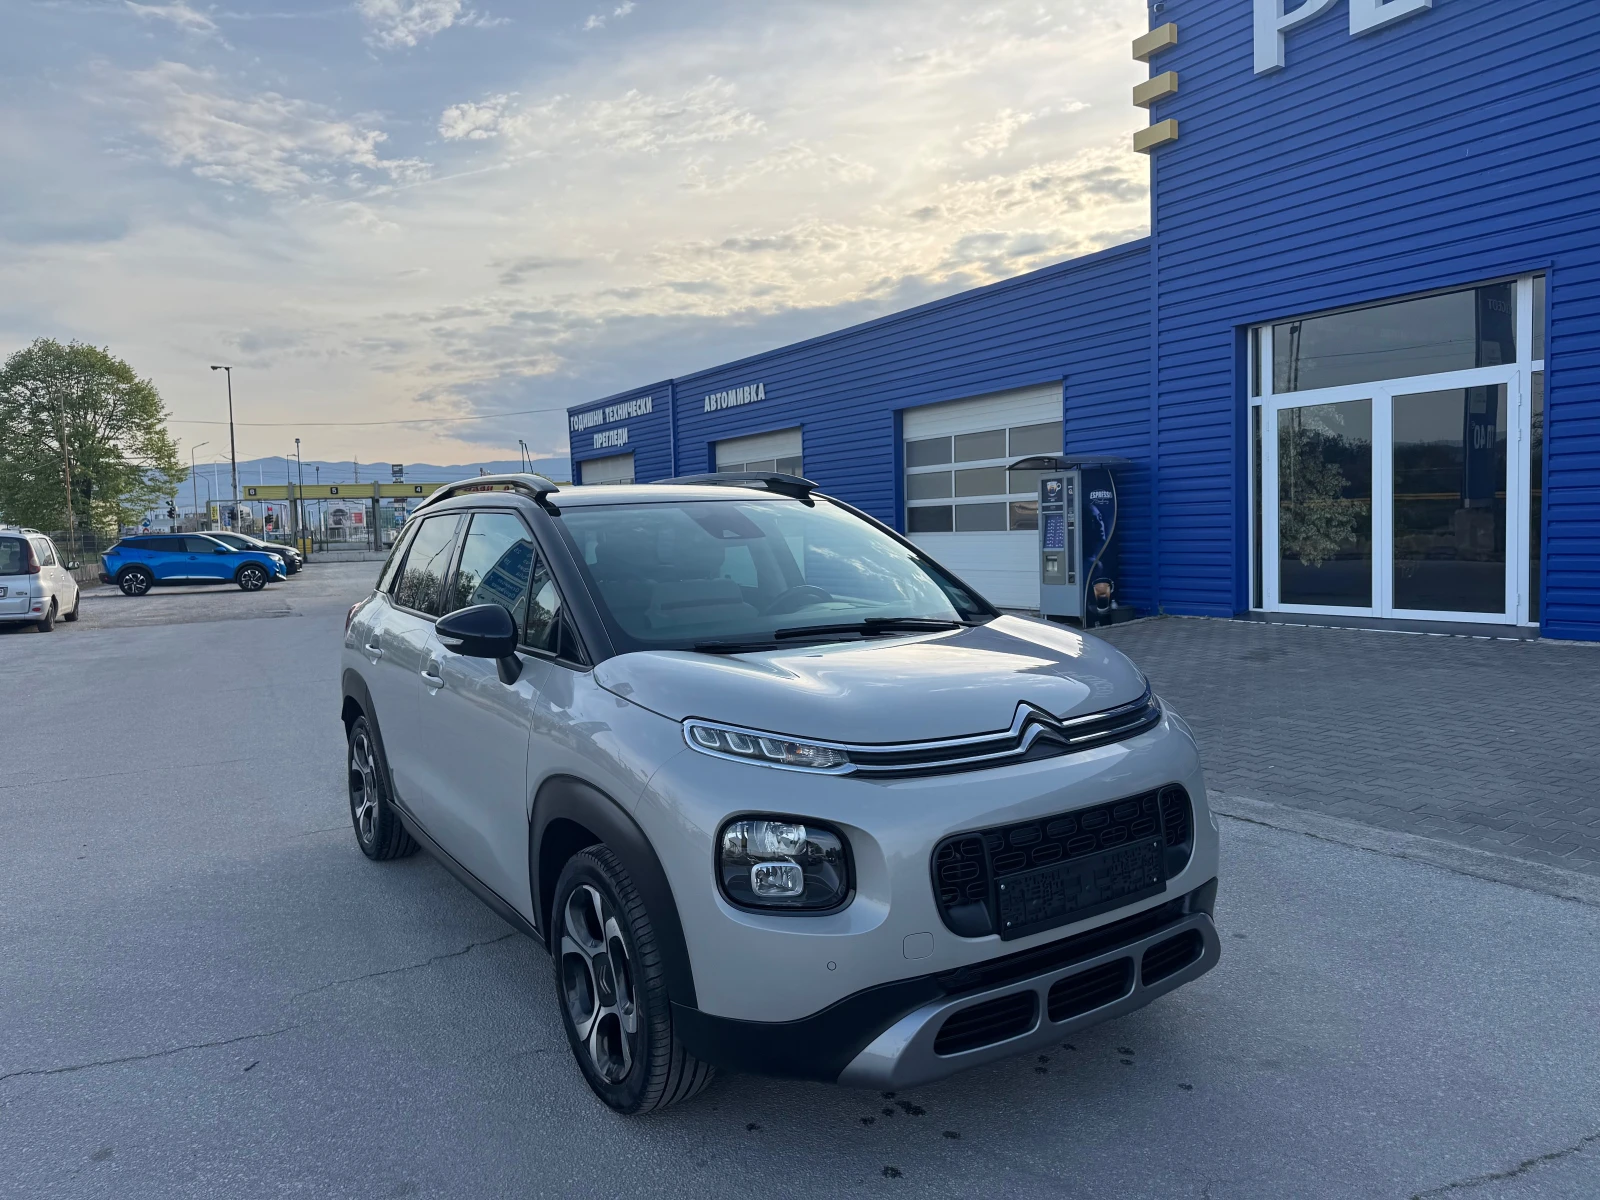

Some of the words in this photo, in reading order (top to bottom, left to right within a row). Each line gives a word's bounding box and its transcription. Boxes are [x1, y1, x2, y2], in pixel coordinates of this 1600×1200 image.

[704, 382, 765, 413] АВТОМИВКА
[570, 409, 603, 432] ГОДИШНИ
[605, 396, 653, 423] ТЕХНИЧЕСКИ
[593, 427, 628, 449] ПРЕГЛЕДИ
